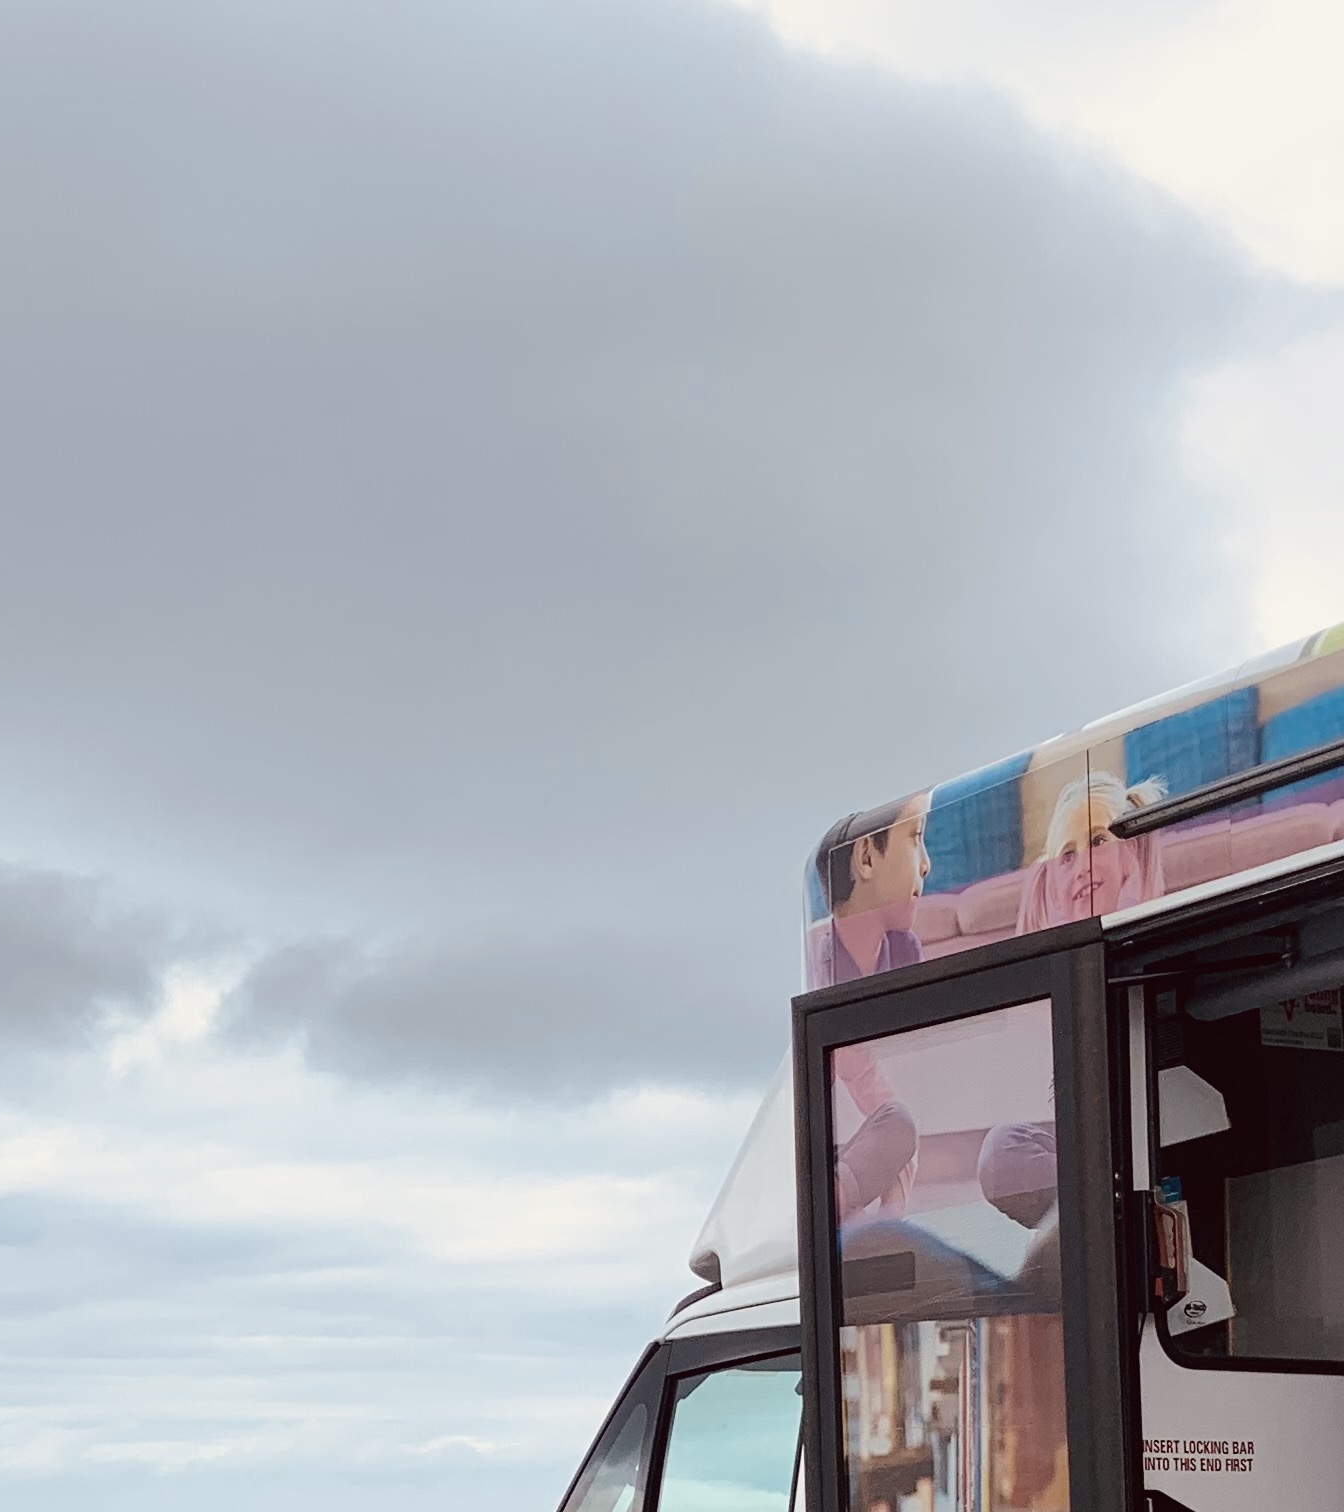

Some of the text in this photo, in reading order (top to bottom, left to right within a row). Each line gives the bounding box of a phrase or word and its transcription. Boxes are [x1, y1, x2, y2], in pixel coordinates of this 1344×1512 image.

[1183, 1440, 1229, 1455] LOCKING
[1232, 1441, 1255, 1455] BAR
[1144, 1457, 1254, 1472] INTO THIS END FIRST
